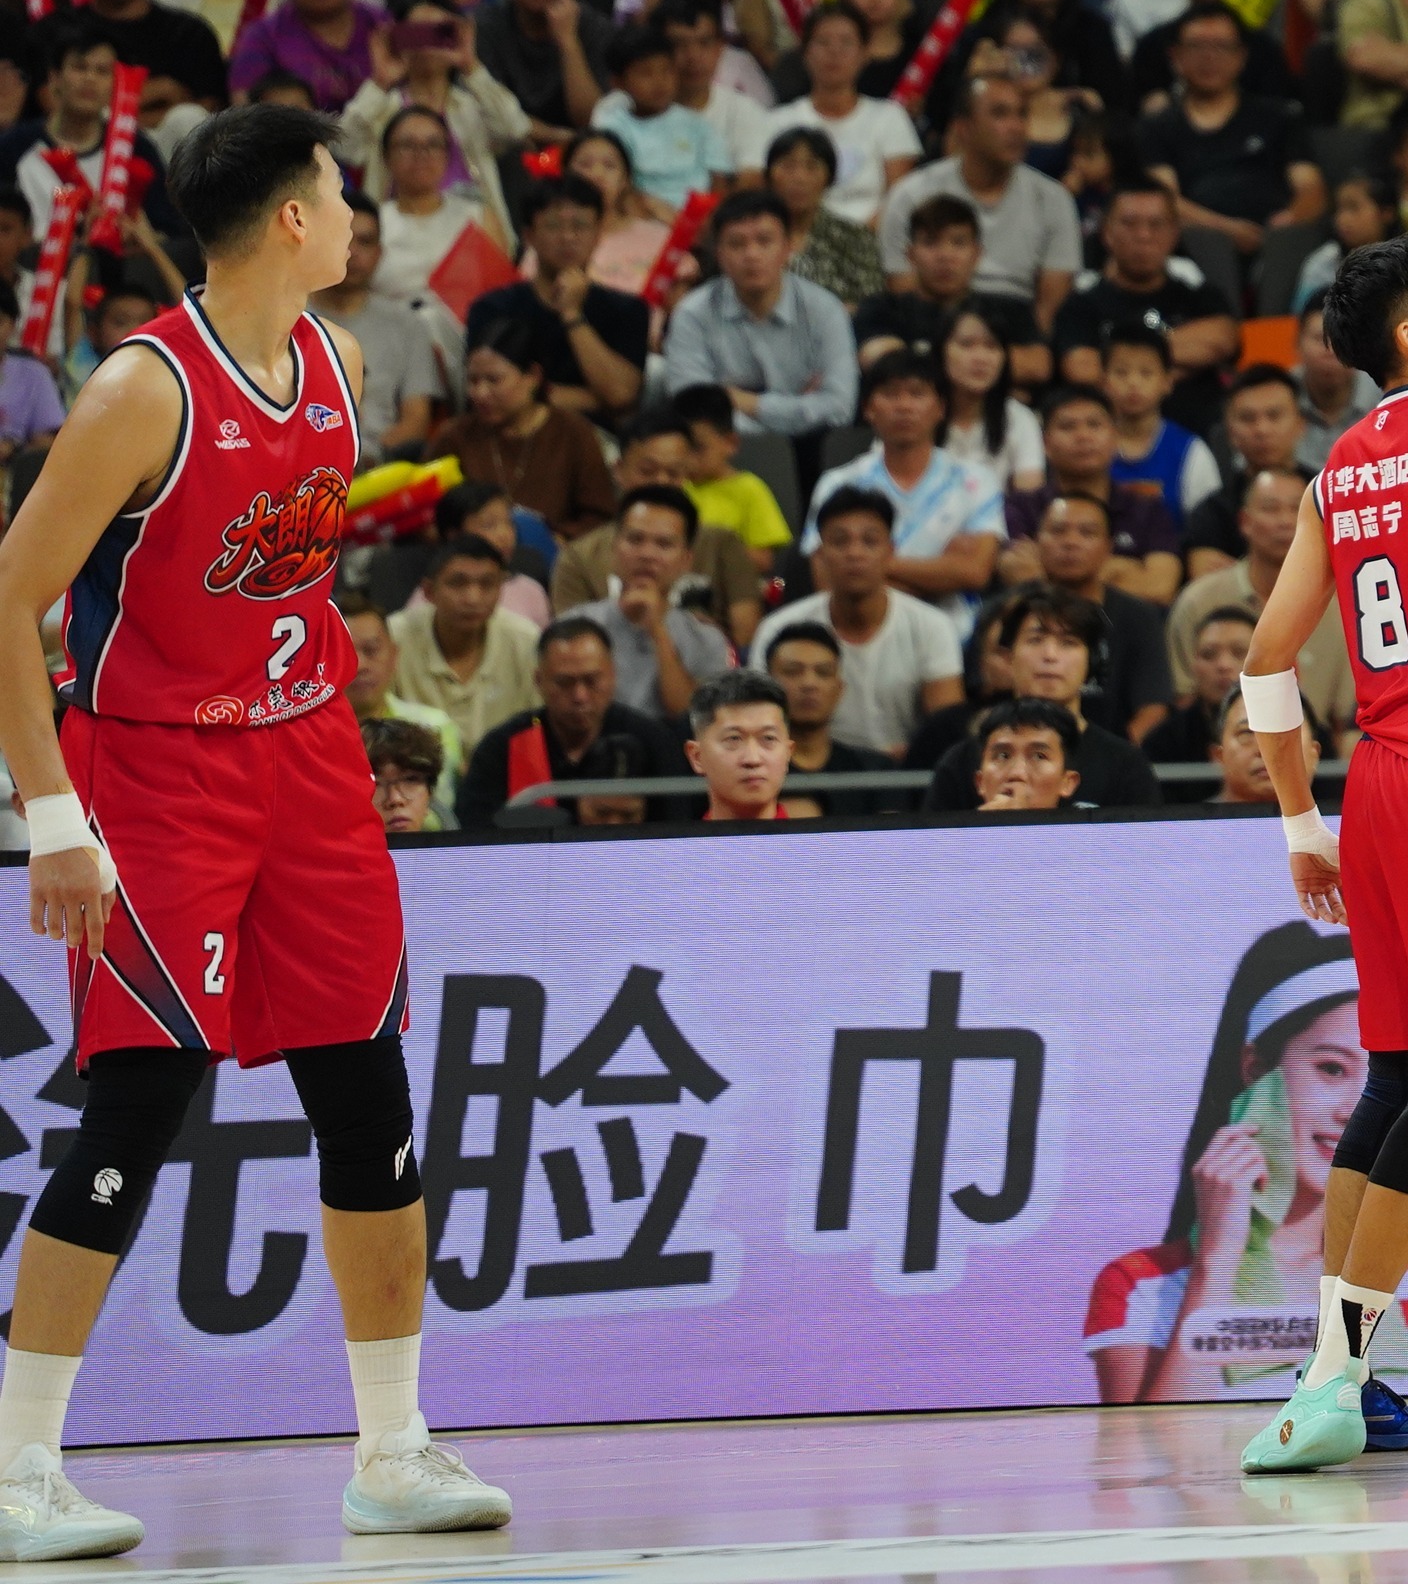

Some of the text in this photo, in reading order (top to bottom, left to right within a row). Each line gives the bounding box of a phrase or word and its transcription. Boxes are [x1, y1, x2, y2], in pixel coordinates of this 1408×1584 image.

[1332, 501, 1403, 545] 周志宁
[265, 614, 307, 681] 2
[203, 930, 226, 996] 2
